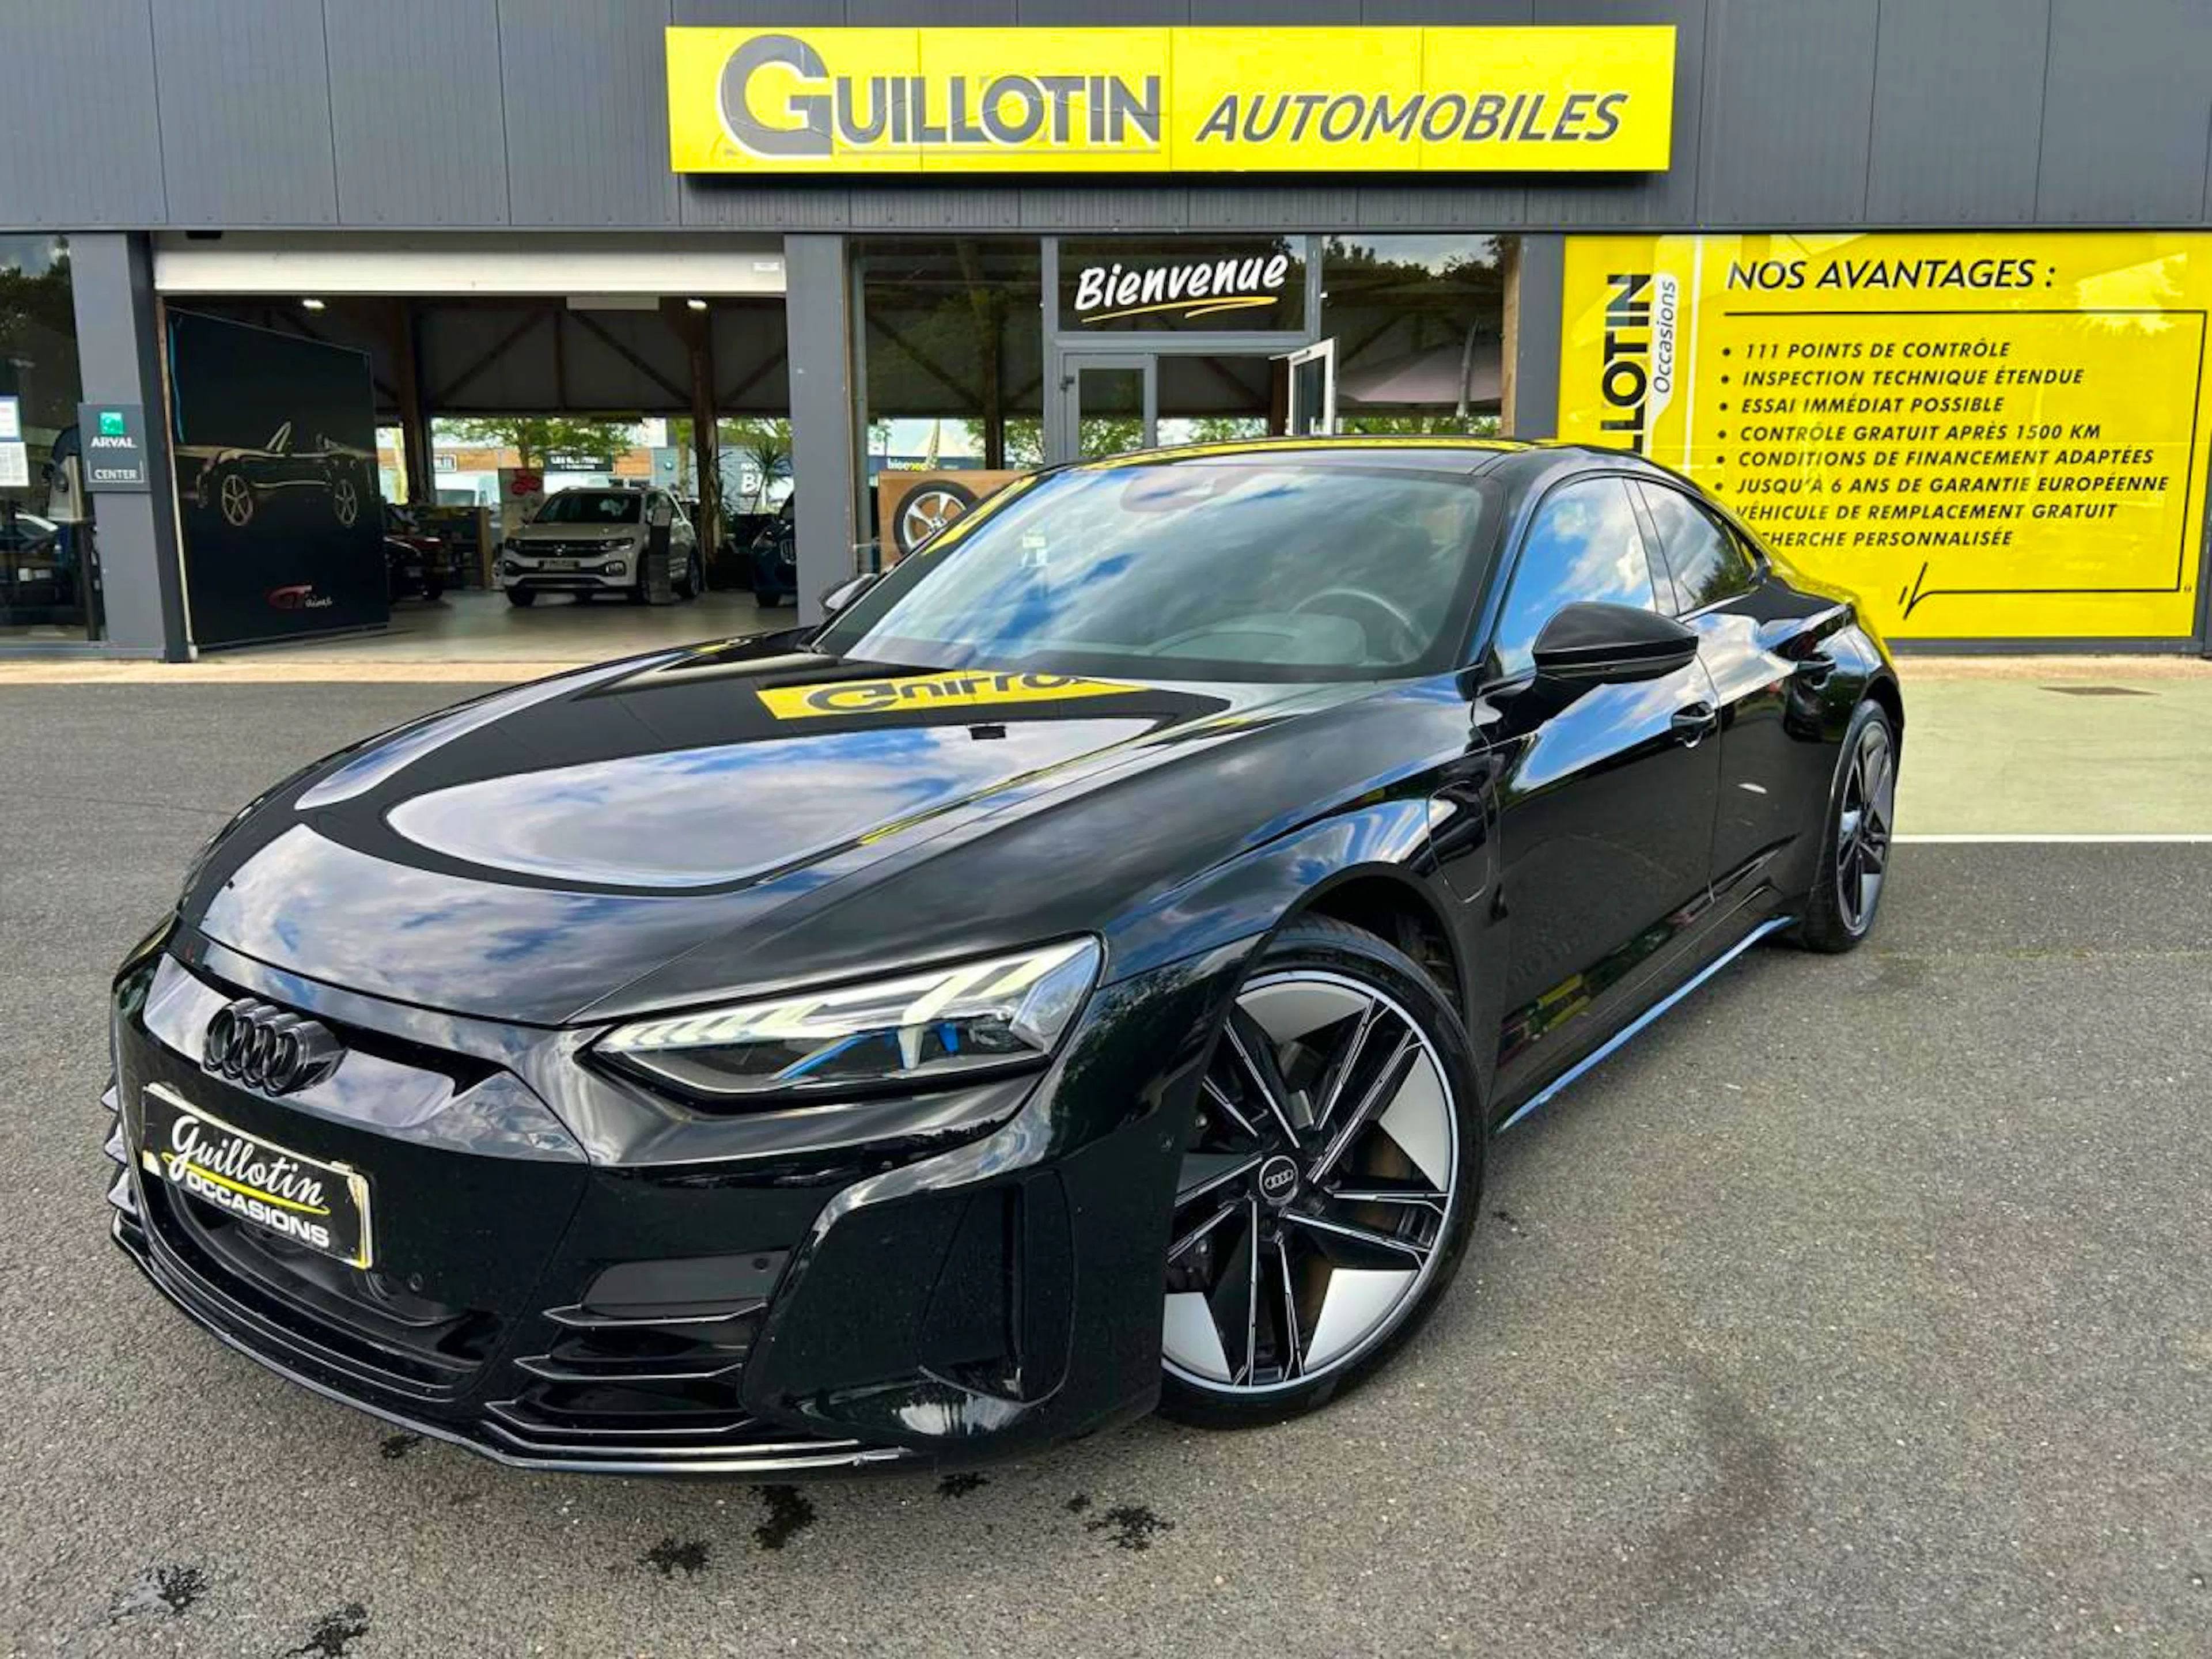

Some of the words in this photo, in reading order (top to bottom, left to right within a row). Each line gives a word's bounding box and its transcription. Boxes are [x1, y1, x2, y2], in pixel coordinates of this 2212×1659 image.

[720, 33, 1161, 158] GUILLOTIN
[1196, 92, 1628, 144] AUTOMOBILES
[1074, 253, 1289, 311] Bienvenue
[1728, 260, 1807, 290] NOS
[1815, 259, 2036, 289] AVANTAGES
[1653, 281, 1676, 393] Occasions
[1744, 344, 1778, 358] 111
[1787, 343, 1862, 358] POINTS
[1870, 343, 1895, 358] DE
[1903, 339, 2010, 358] CONTRÔLE
[1743, 370, 1865, 386] INSPECTION
[1873, 370, 1988, 386] TECHNIQUE
[1994, 365, 2084, 384] ÉTENDUE
[1741, 399, 1796, 413] ESSAI
[1802, 393, 1904, 412] IMMÉDIAT
[1911, 397, 2004, 412] POSSIBLE
[1740, 422, 1846, 441] CONTRÔLE
[1854, 426, 1940, 441] GRATUIT
[1945, 421, 2008, 440] APRÈS
[2017, 425, 2062, 440] 1500
[2070, 425, 2101, 440] KM
[90, 435, 138, 449] ARVAL
[1738, 451, 1866, 467] CONDITIONS
[1873, 451, 1899, 466] DE
[1906, 450, 2050, 465] FINANCEMENT
[2054, 445, 2154, 464] ADAPTÉES
[93, 468, 138, 480] CENTER
[1831, 479, 1842, 493] 6
[1848, 478, 1889, 493] ANS
[1897, 478, 1922, 493] DE
[1930, 477, 2031, 493] GARANTIE
[2037, 472, 2169, 492] EUROPÉENNE
[1836, 505, 1861, 519] DE
[1867, 504, 2024, 520] REMPLACEMENT
[2032, 503, 2118, 519] GRATUIT
[1853, 527, 2013, 547] PERSONNALISÉE
[168, 1115, 324, 1208] Guillotin
[185, 1173, 330, 1248] OCCASIONS
